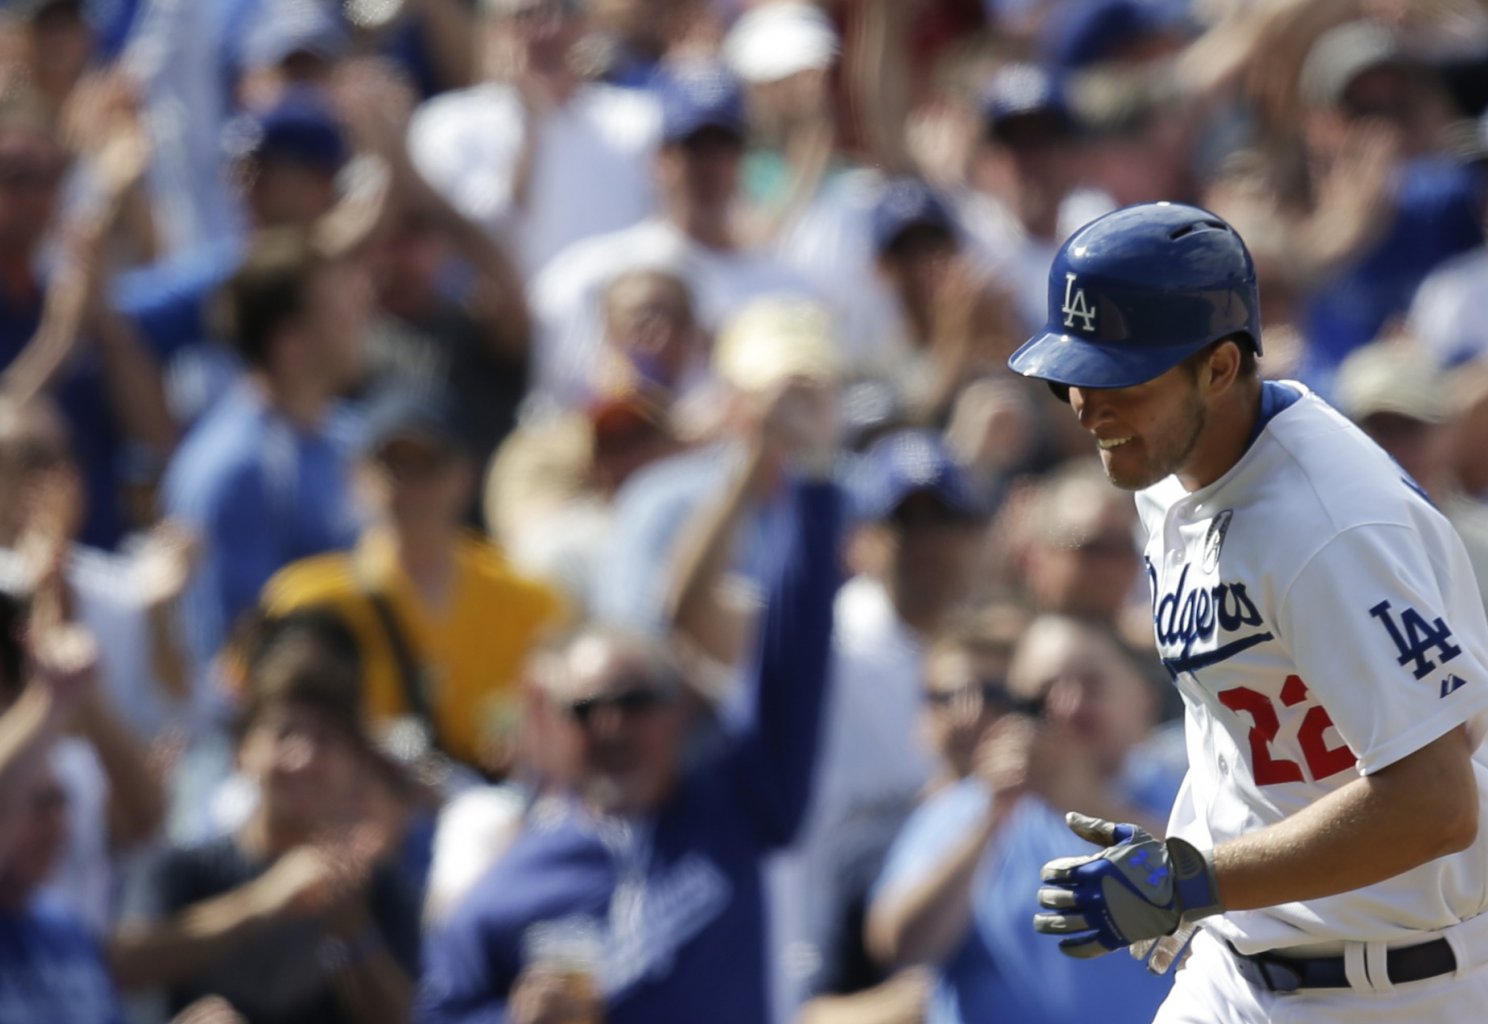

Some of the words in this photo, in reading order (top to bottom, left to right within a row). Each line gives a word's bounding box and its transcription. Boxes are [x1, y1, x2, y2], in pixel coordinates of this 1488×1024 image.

[1062, 271, 1095, 331] LA
[1145, 556, 1272, 676] dgers
[1369, 599, 1462, 680] LA
[1218, 674, 1358, 787] 22
